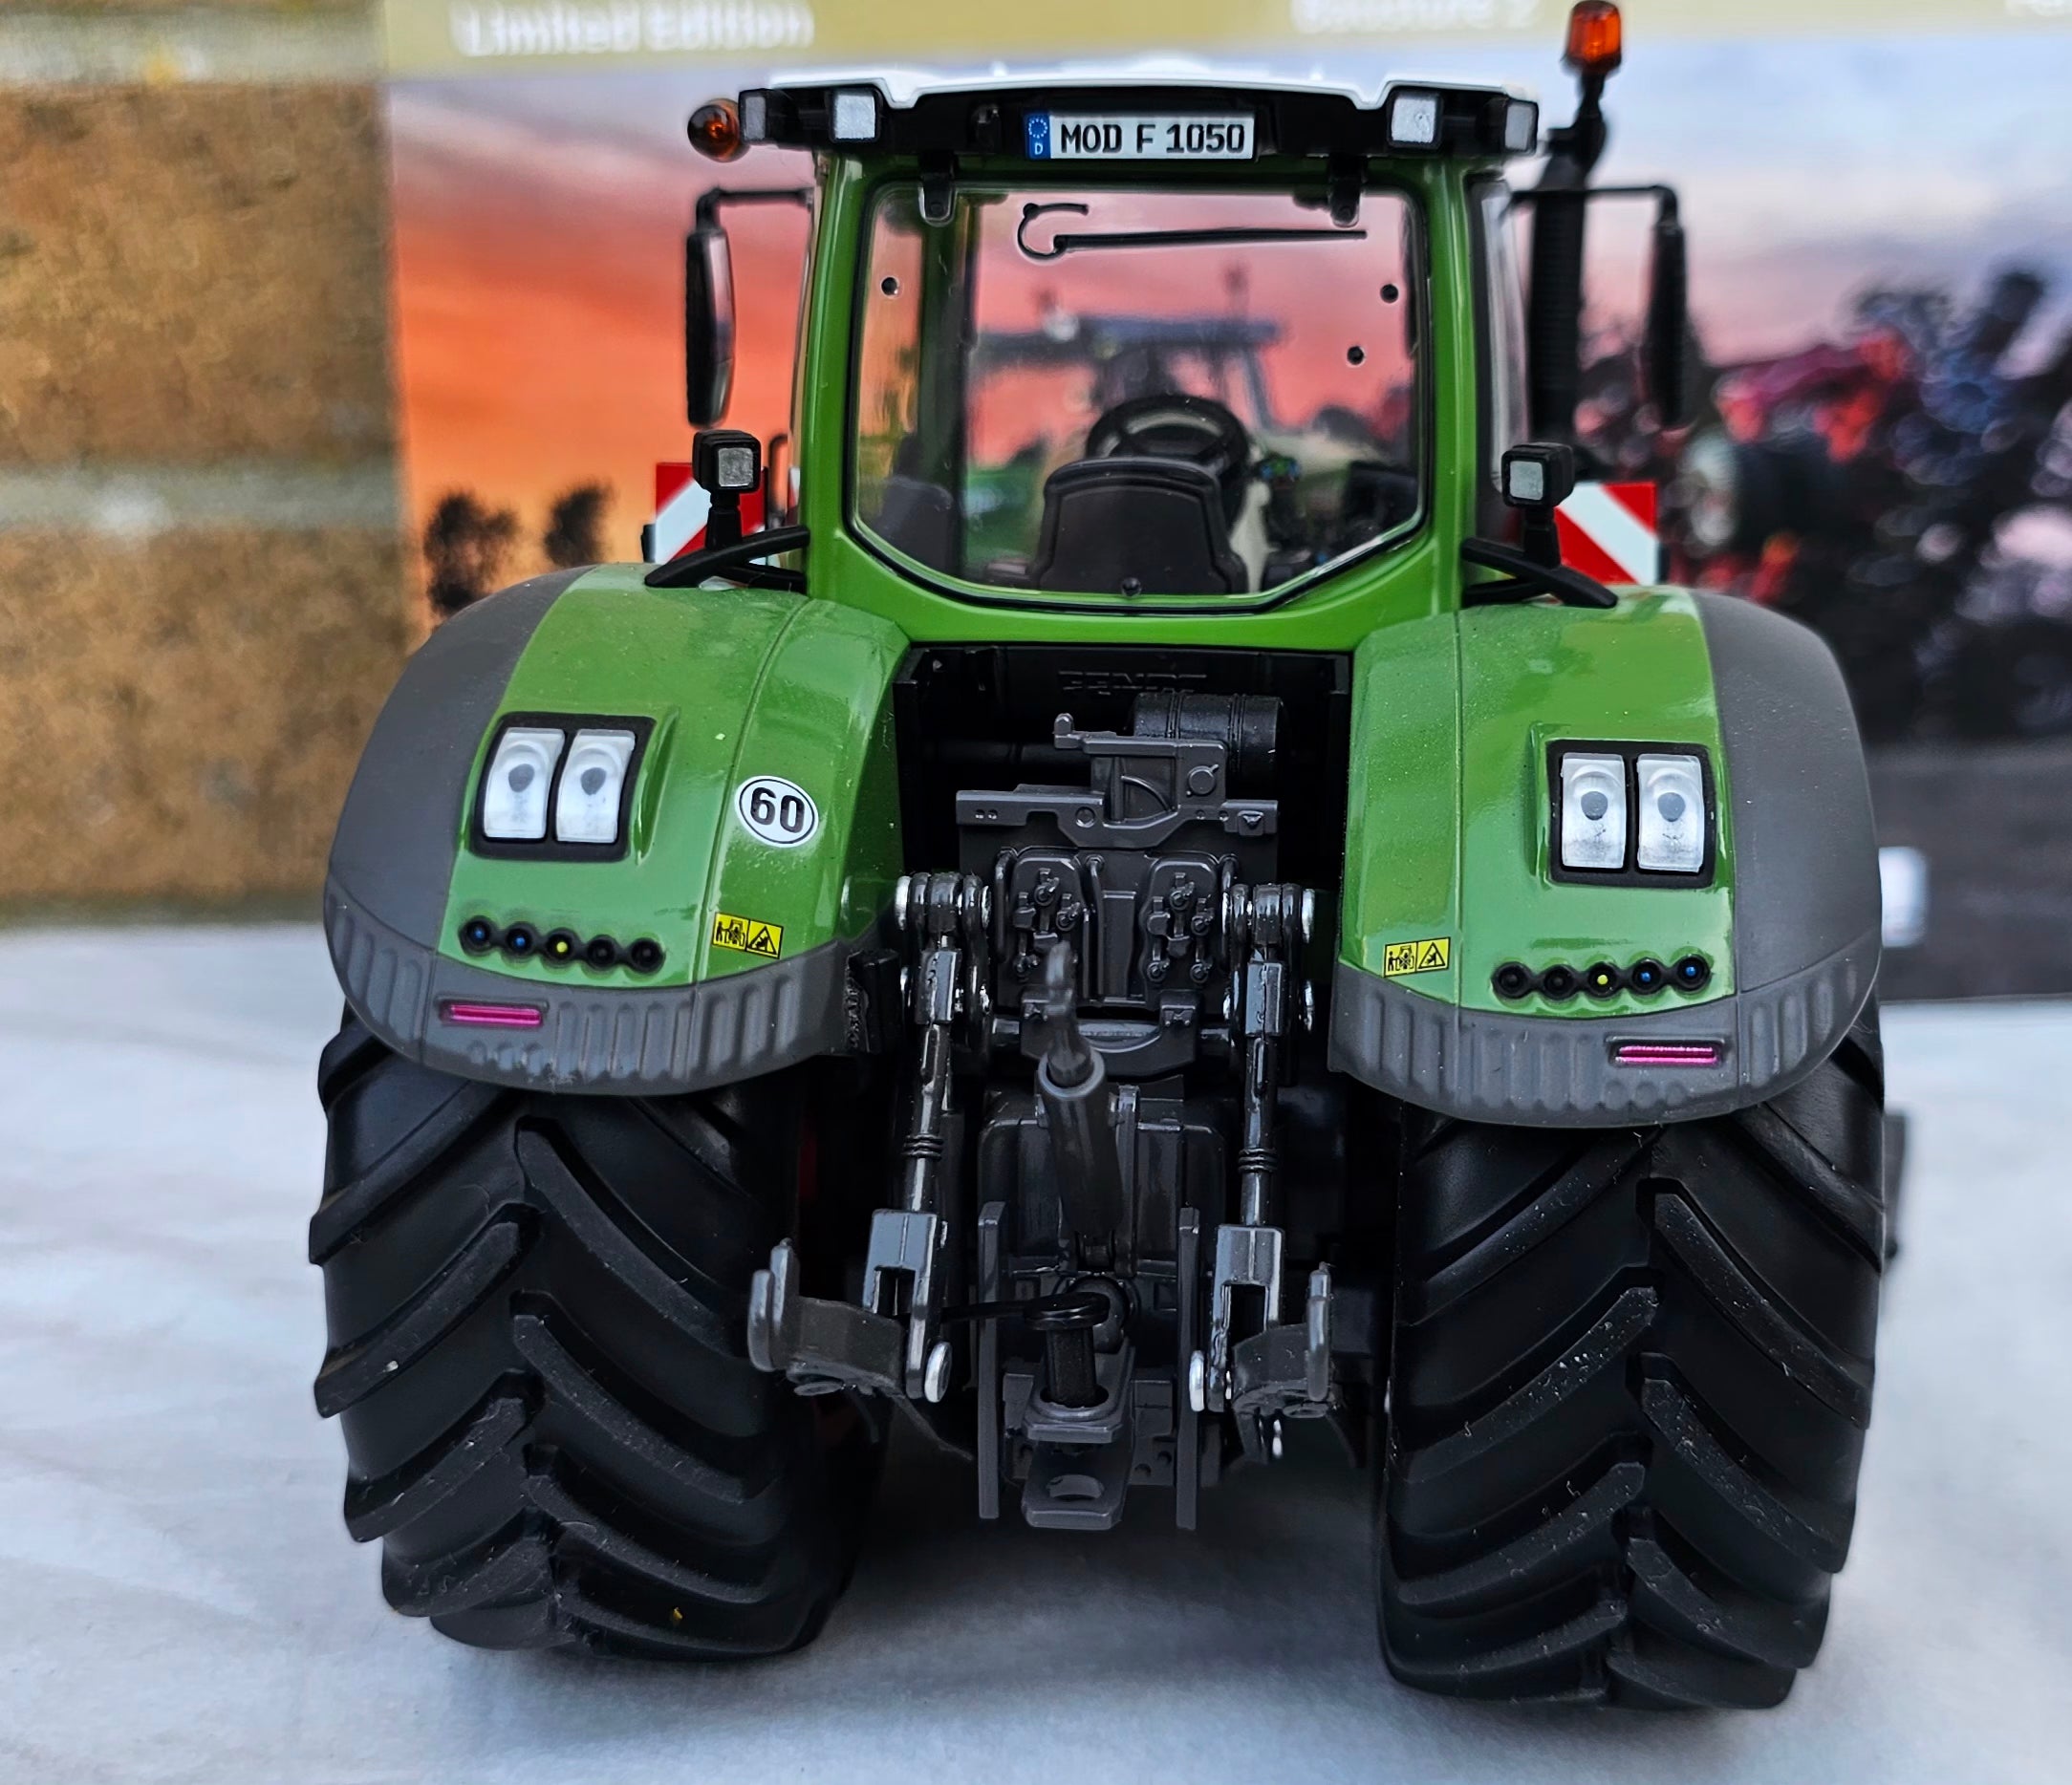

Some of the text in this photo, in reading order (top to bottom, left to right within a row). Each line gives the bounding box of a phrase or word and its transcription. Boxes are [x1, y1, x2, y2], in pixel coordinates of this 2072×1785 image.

[1034, 142, 1044, 155] D
[1060, 124, 1245, 154] MOD F 1050
[750, 786, 805, 833] 60
